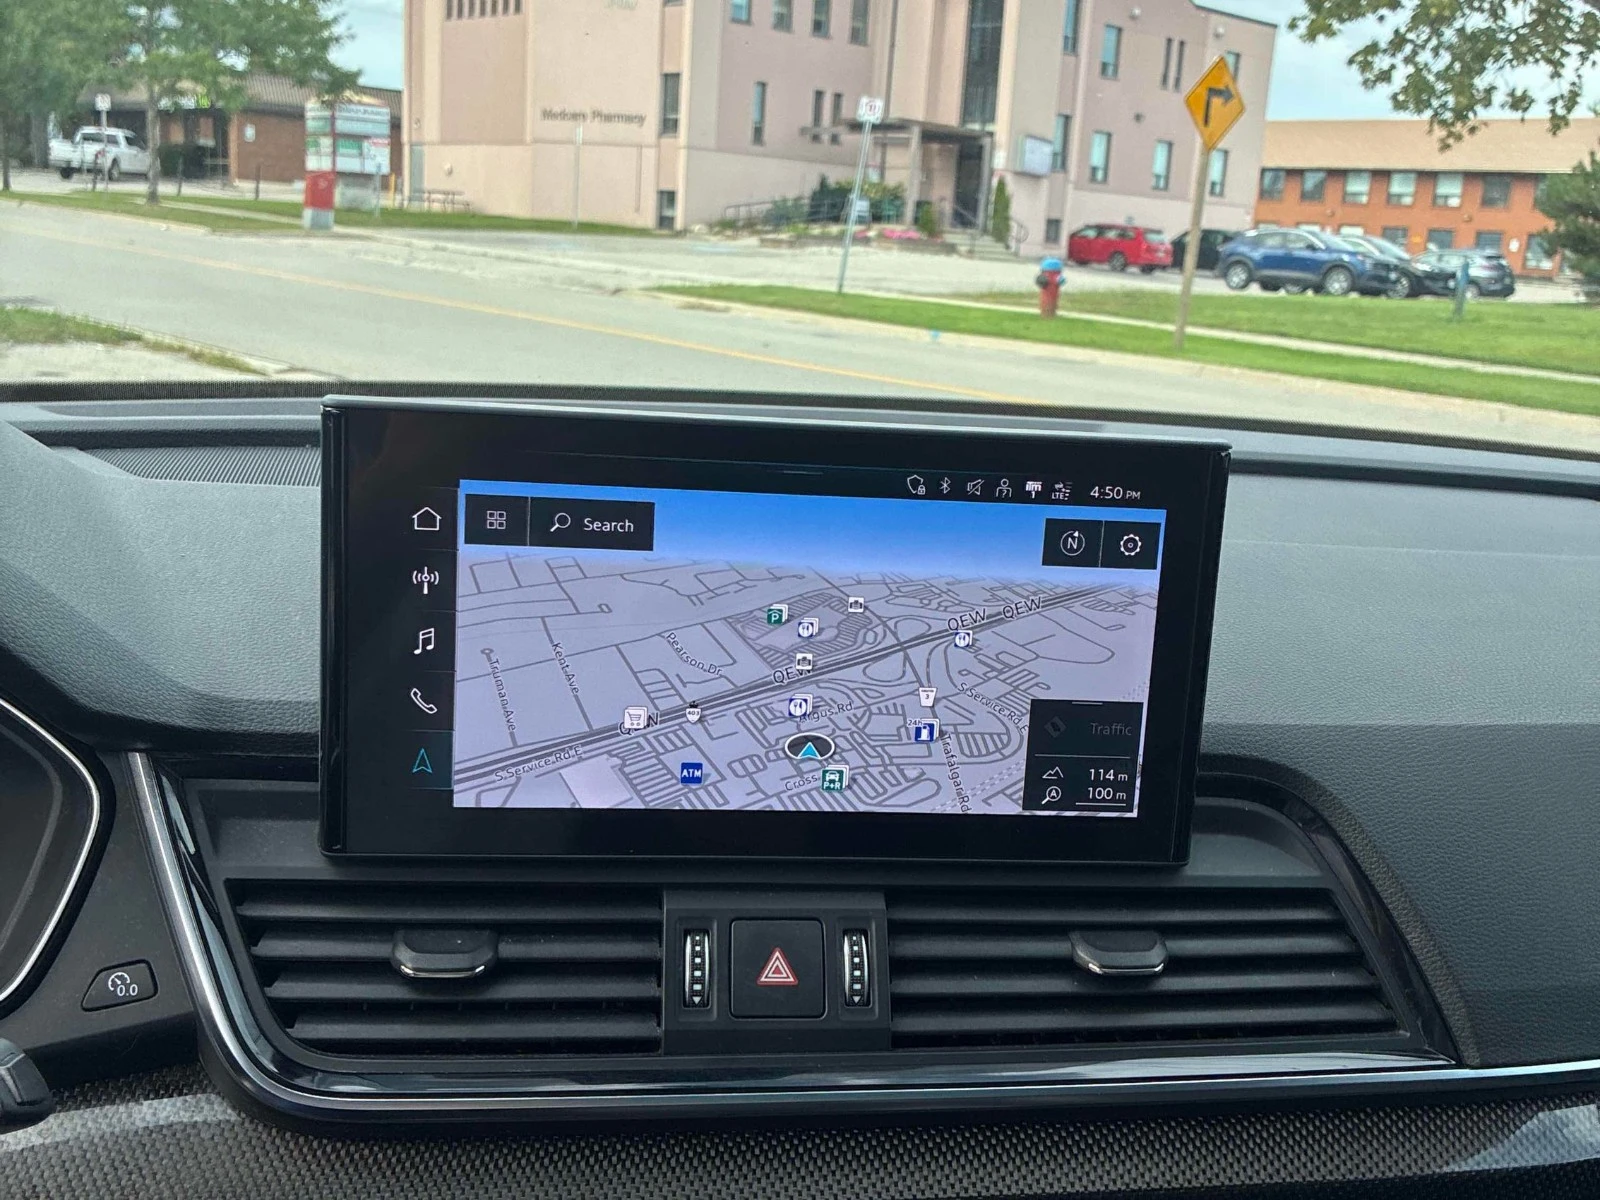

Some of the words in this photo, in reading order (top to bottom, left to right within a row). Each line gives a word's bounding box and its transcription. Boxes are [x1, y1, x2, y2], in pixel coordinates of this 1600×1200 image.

[591, 108, 647, 128] Pharmacy
[1052, 491, 1065, 500] LTE
[1090, 485, 1123, 500] 4:50
[1126, 490, 1141, 500] PM
[583, 517, 635, 533] Search
[1003, 596, 1041, 620] QEW
[947, 608, 986, 631] QEW
[666, 631, 705, 672] Pearson
[707, 662, 722, 676] Dr
[552, 642, 571, 671] Kent
[565, 673, 580, 695] Ave
[489, 658, 509, 707] Truman
[503, 709, 516, 731] Ave
[837, 701, 853, 713] Rd
[959, 682, 968, 693] S
[966, 687, 1006, 715] Service
[1007, 710, 1022, 727] Rd
[1020, 724, 1030, 735] E
[1090, 722, 1132, 736] Traffic
[494, 770, 503, 782] S
[506, 757, 552, 777] Service
[555, 749, 572, 763] Rd
[574, 745, 583, 757] E
[681, 768, 702, 779] ATM
[940, 734, 964, 793] Trafalgar
[958, 795, 972, 813] Rd
[1089, 768, 1115, 781] 114
[1117, 773, 1128, 782] m
[785, 774, 818, 791] Cross
[823, 781, 841, 790] P+R
[1087, 787, 1113, 800] 100
[1116, 792, 1127, 800] m
[117, 984, 138, 997] 0.0
